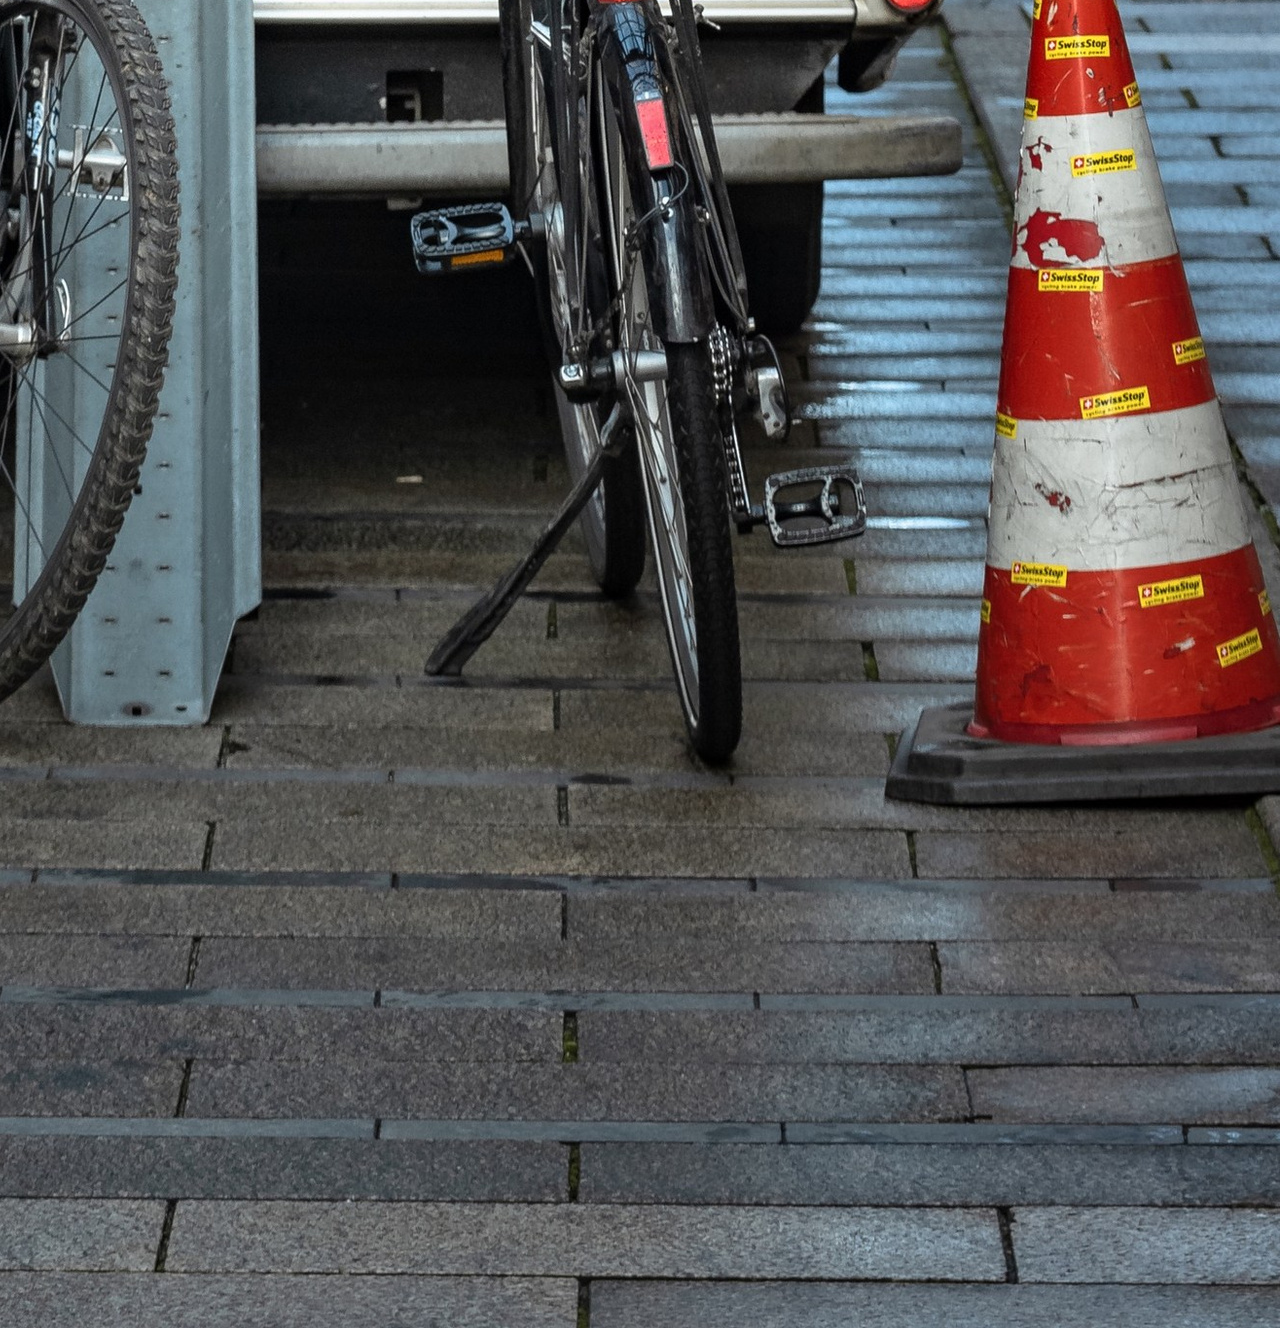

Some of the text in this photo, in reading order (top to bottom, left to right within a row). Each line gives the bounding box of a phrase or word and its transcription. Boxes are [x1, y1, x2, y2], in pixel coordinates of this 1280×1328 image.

[1058, 39, 1107, 49] SwissStop
[1086, 154, 1134, 167] SwissStop
[1051, 272, 1100, 284] SwissStop
[1095, 391, 1145, 408] SwissStop
[1021, 564, 1064, 579] SwissStop
[1153, 581, 1200, 596] SwissStop
